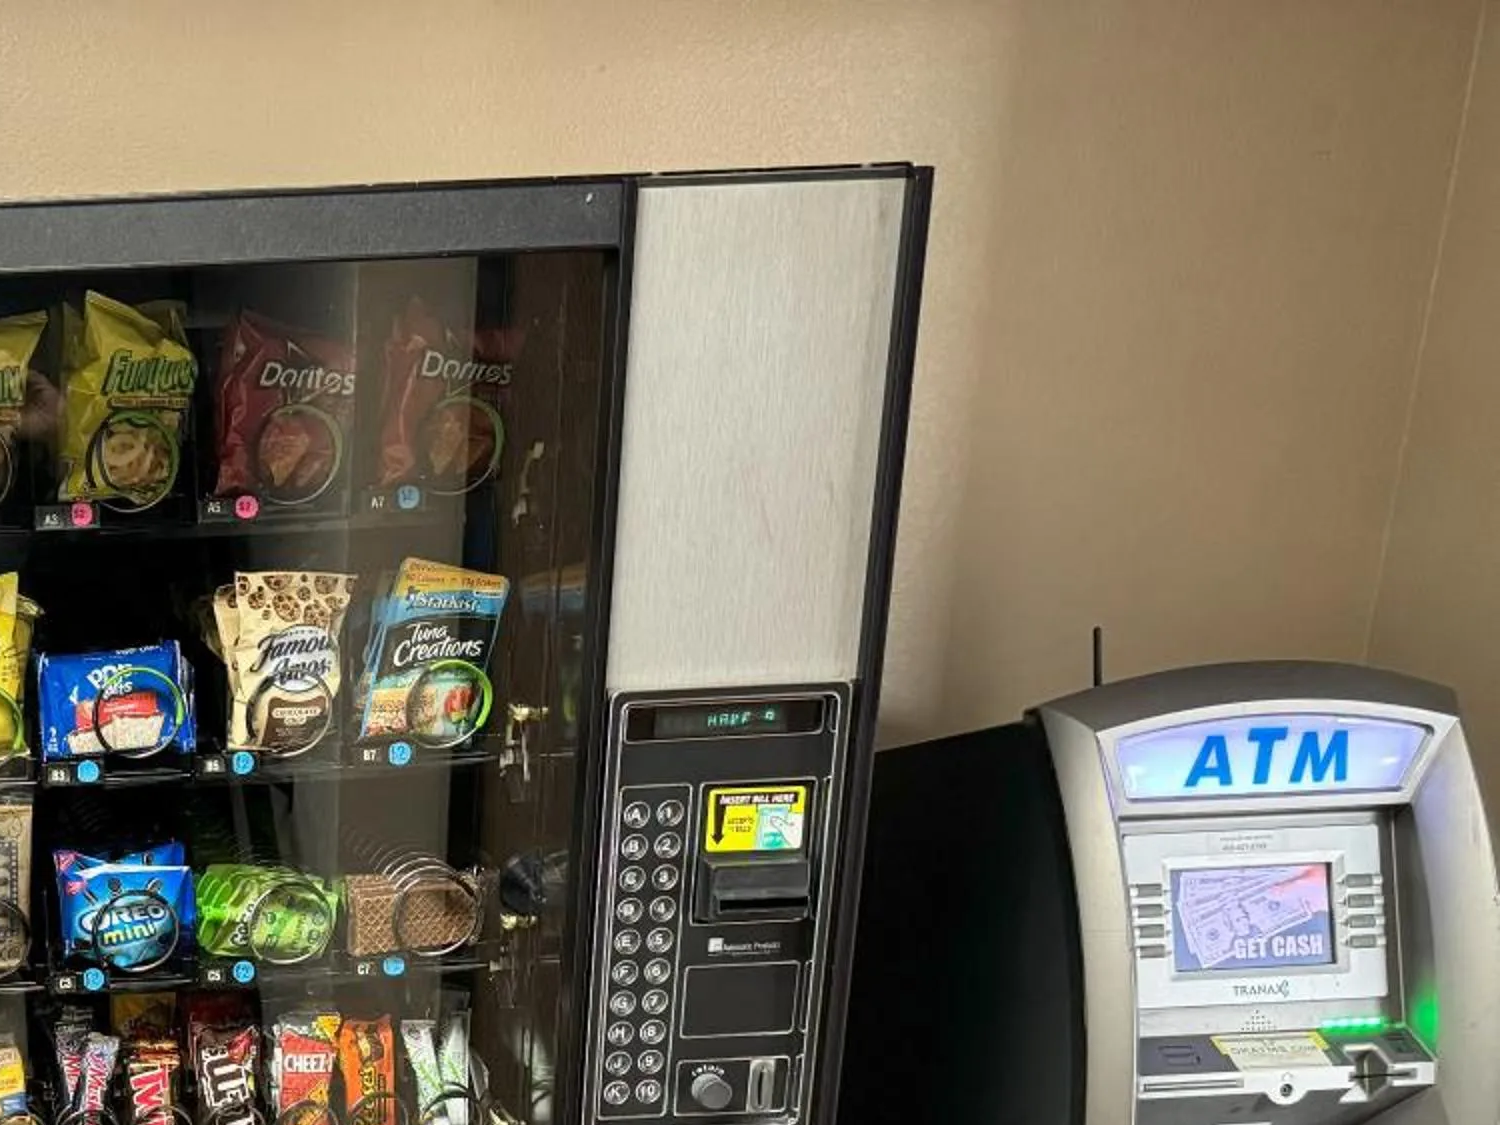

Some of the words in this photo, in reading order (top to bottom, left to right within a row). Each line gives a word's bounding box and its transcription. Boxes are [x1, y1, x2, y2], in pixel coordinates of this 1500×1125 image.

[260, 361, 356, 396] Doritos
[421, 350, 513, 386] Doritos
[406, 621, 449, 643] Tuna
[393, 638, 484, 667] Creations
[1183, 726, 1350, 788] ATM
[81, 903, 165, 932] OREO
[103, 924, 155, 945] mini
[1234, 936, 1268, 960] GET
[1271, 932, 1323, 957] CASH
[642, 1085, 655, 1096] 10
